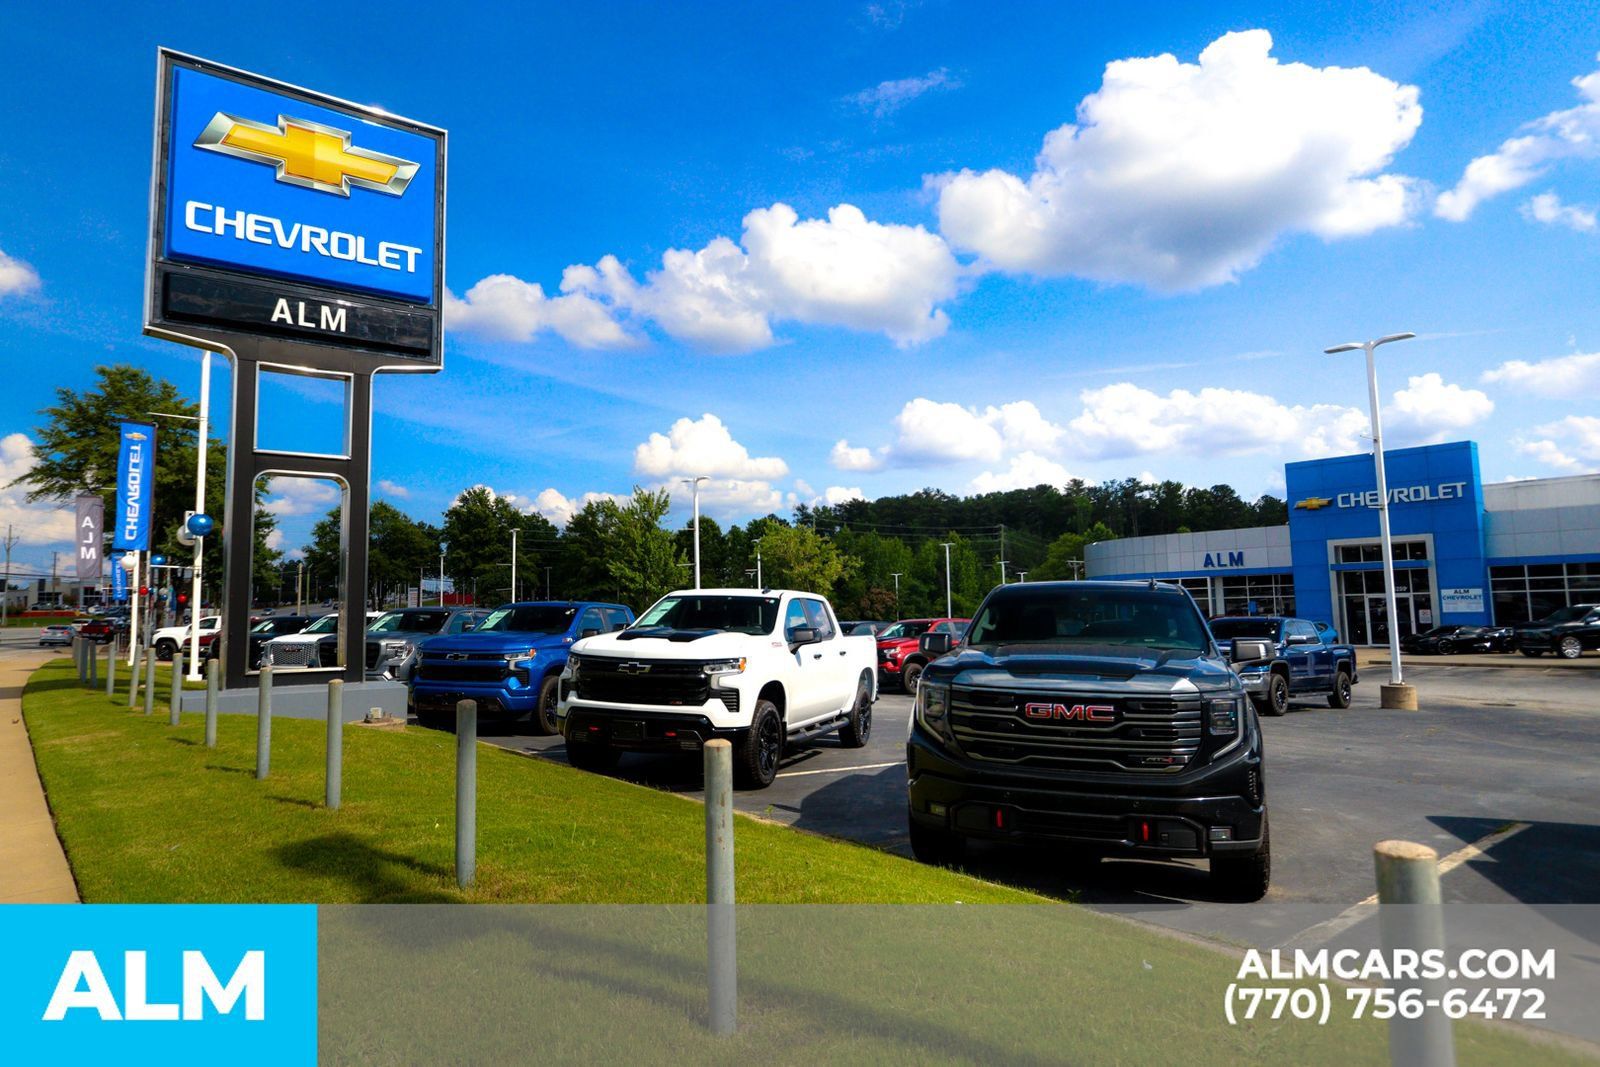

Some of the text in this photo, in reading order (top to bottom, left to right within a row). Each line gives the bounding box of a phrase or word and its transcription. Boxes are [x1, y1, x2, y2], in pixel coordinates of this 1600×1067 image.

[185, 200, 422, 273] CHEVROLET
[271, 298, 347, 332] ALM
[1203, 551, 1244, 568] ALM
[1024, 702, 1115, 722] GMC
